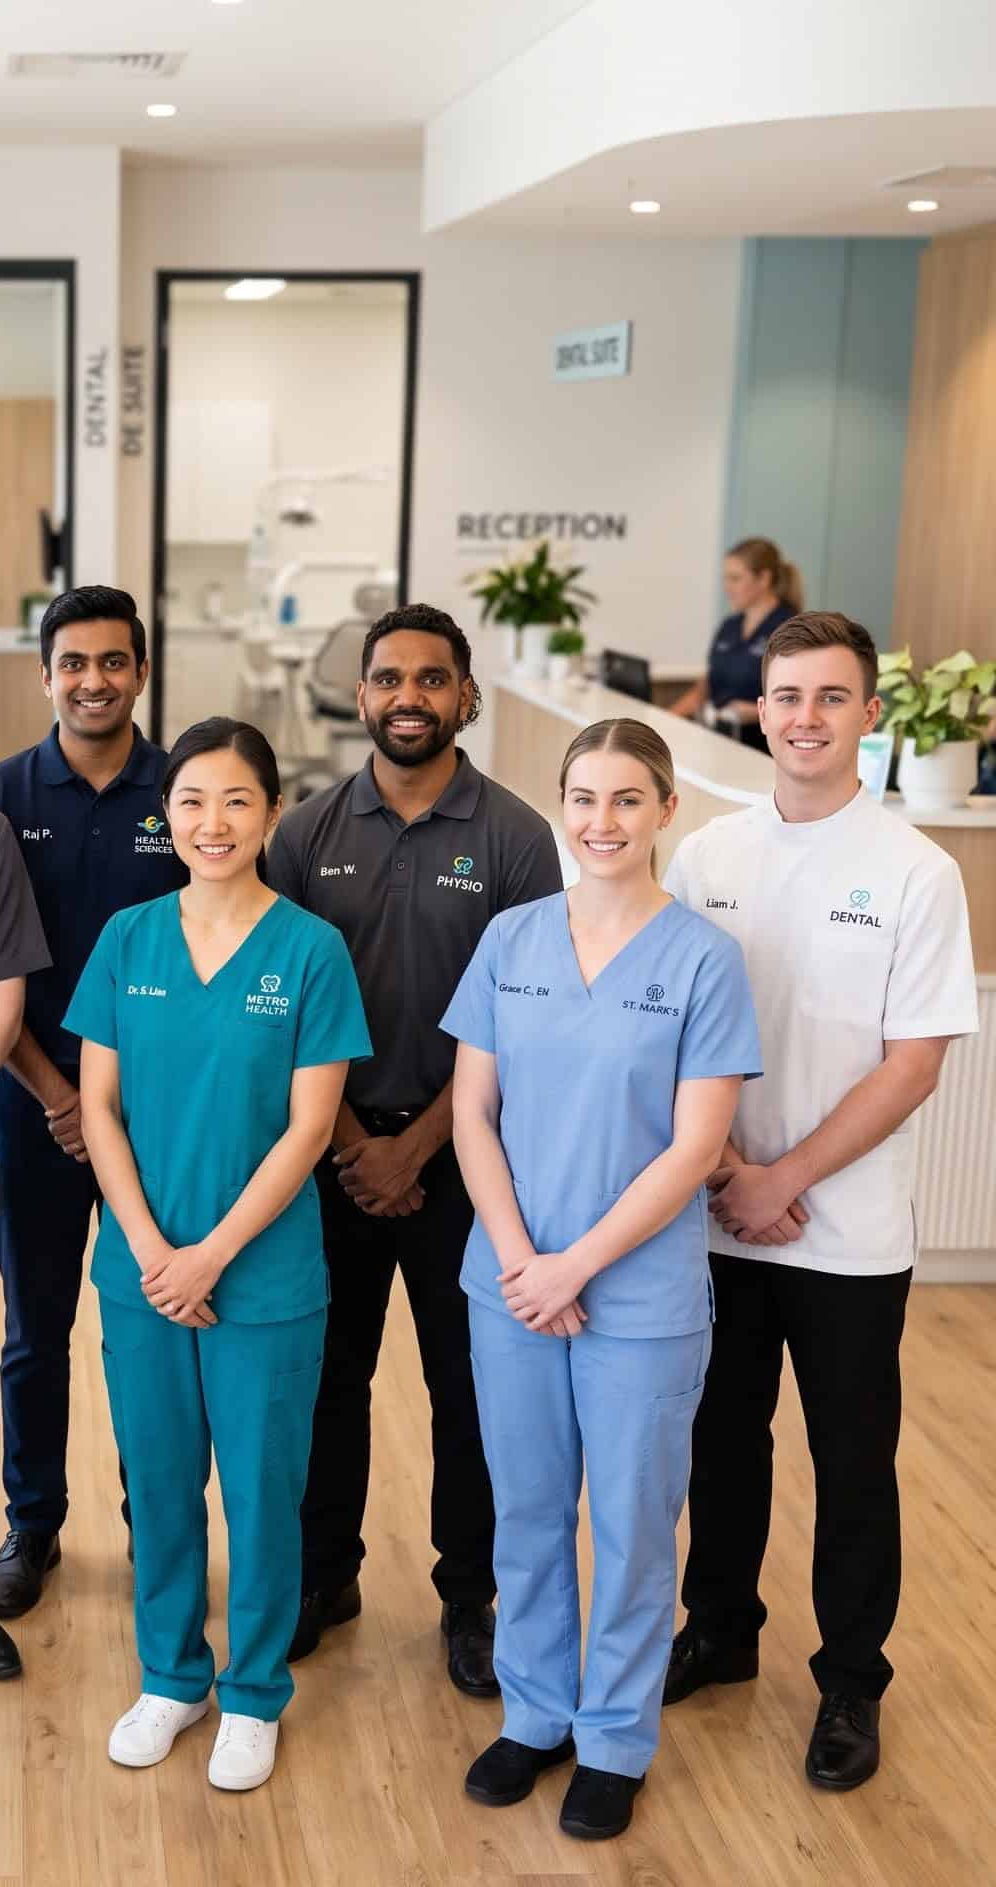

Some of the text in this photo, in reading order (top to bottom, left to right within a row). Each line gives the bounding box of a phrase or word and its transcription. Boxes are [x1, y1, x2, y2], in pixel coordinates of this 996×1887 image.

[121, 345, 145, 414] SUITE
[86, 347, 108, 447] DENTAL
[457, 513, 629, 540] RECEPTION
[22, 829, 53, 840] Raj P.
[134, 836, 173, 845] HEALTH
[134, 845, 173, 854] SCIENCES
[320, 864, 357, 877] Ben W.
[436, 875, 484, 893] PHYSIO
[706, 898, 739, 910] Liam J.
[830, 910, 882, 928] DENTAL
[127, 985, 139, 995] Dr.
[536, 986, 550, 997] EN
[246, 994, 289, 1007] METRO
[245, 1005, 288, 1016] HEALTH
[621, 1000, 679, 1017] ST. MARK'S
